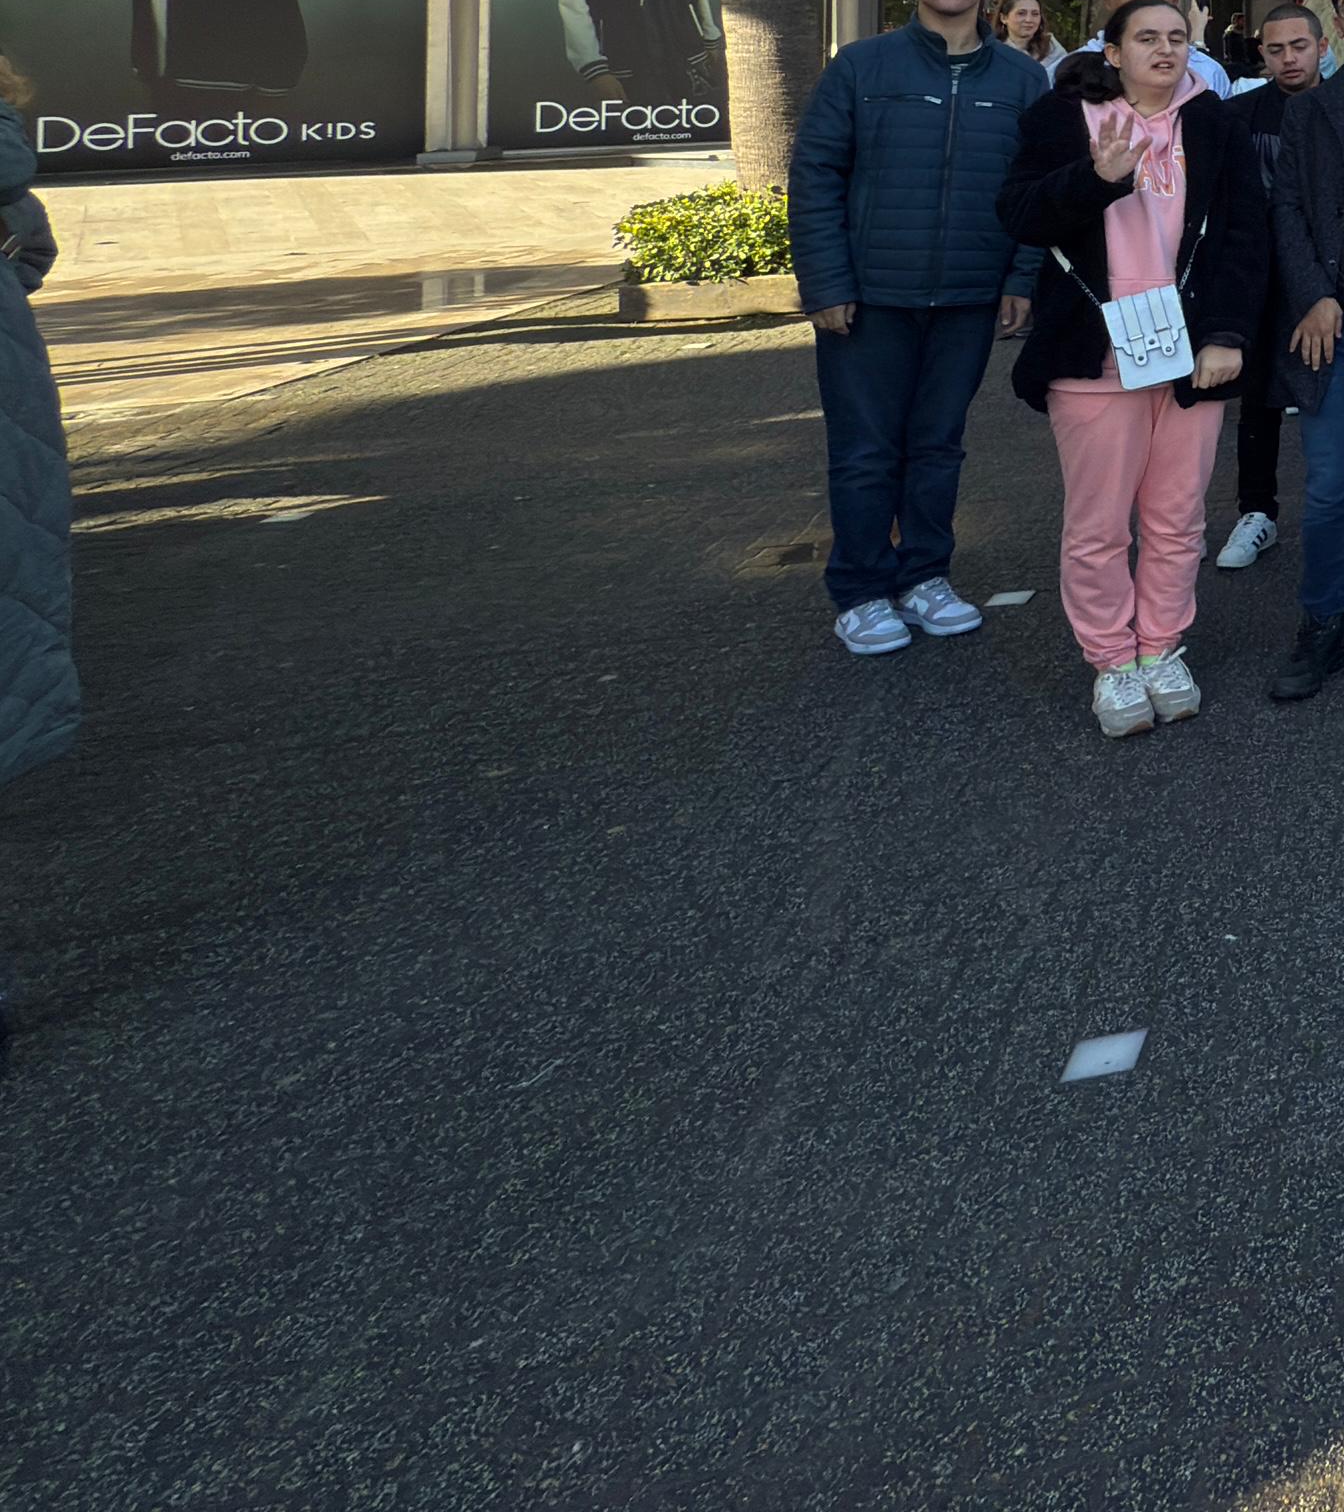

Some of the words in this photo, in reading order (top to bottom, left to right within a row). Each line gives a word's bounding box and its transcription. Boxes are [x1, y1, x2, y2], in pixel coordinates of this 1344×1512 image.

[536, 98, 720, 133] DeFacto
[36, 111, 289, 153] DeFacto
[632, 132, 692, 141] defacto.com
[170, 150, 250, 161] defacto.com
